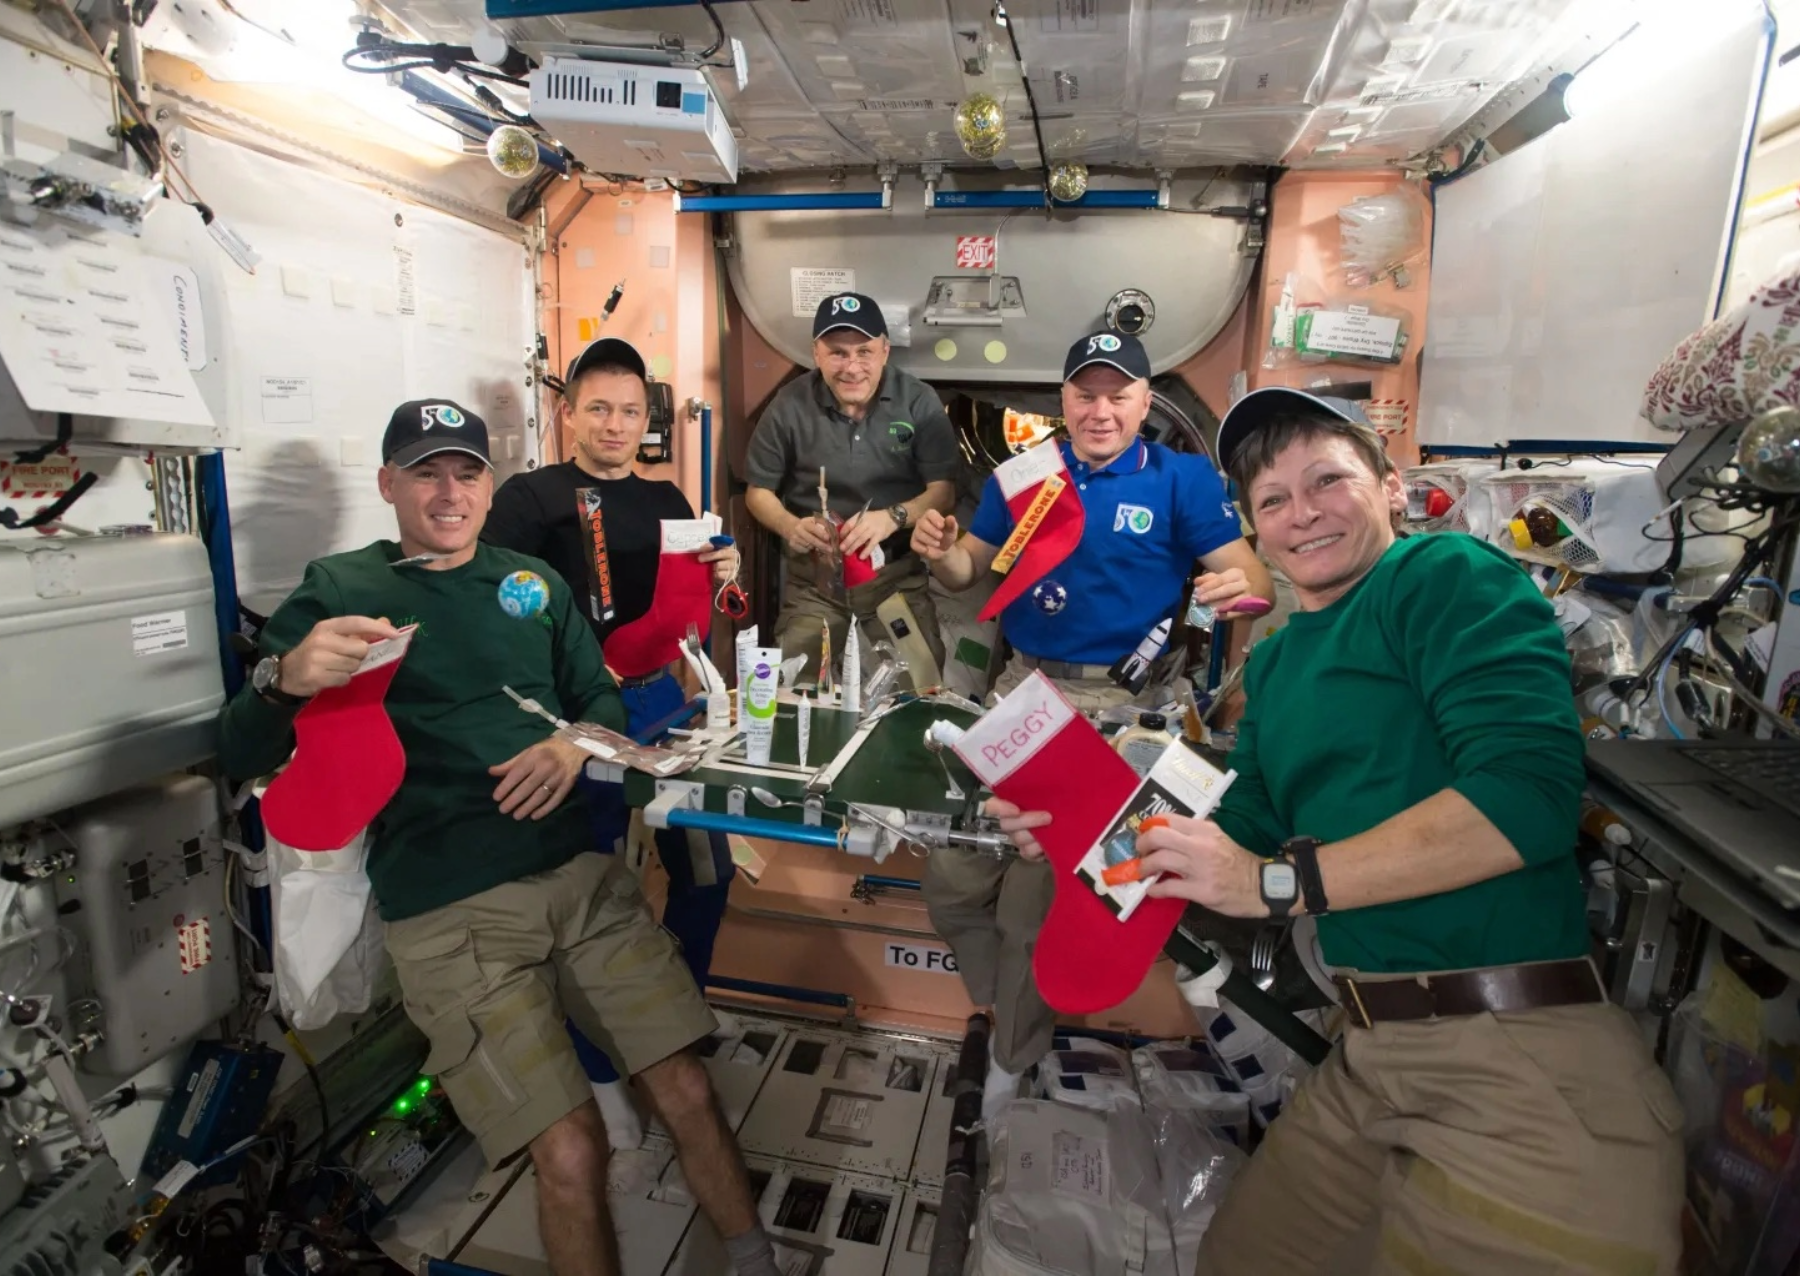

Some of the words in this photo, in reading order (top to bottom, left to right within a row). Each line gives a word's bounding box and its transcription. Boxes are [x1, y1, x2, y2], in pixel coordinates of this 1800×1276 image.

[963, 244, 988, 260] EXIT
[421, 405, 465, 431] 50
[12, 466, 38, 475] FIRE
[41, 466, 70, 474] PORT
[1003, 489, 1056, 559] TOBLERONE
[588, 508, 612, 607] TOBLERONE
[981, 700, 1053, 767] PEGGY
[889, 945, 919, 966] To
